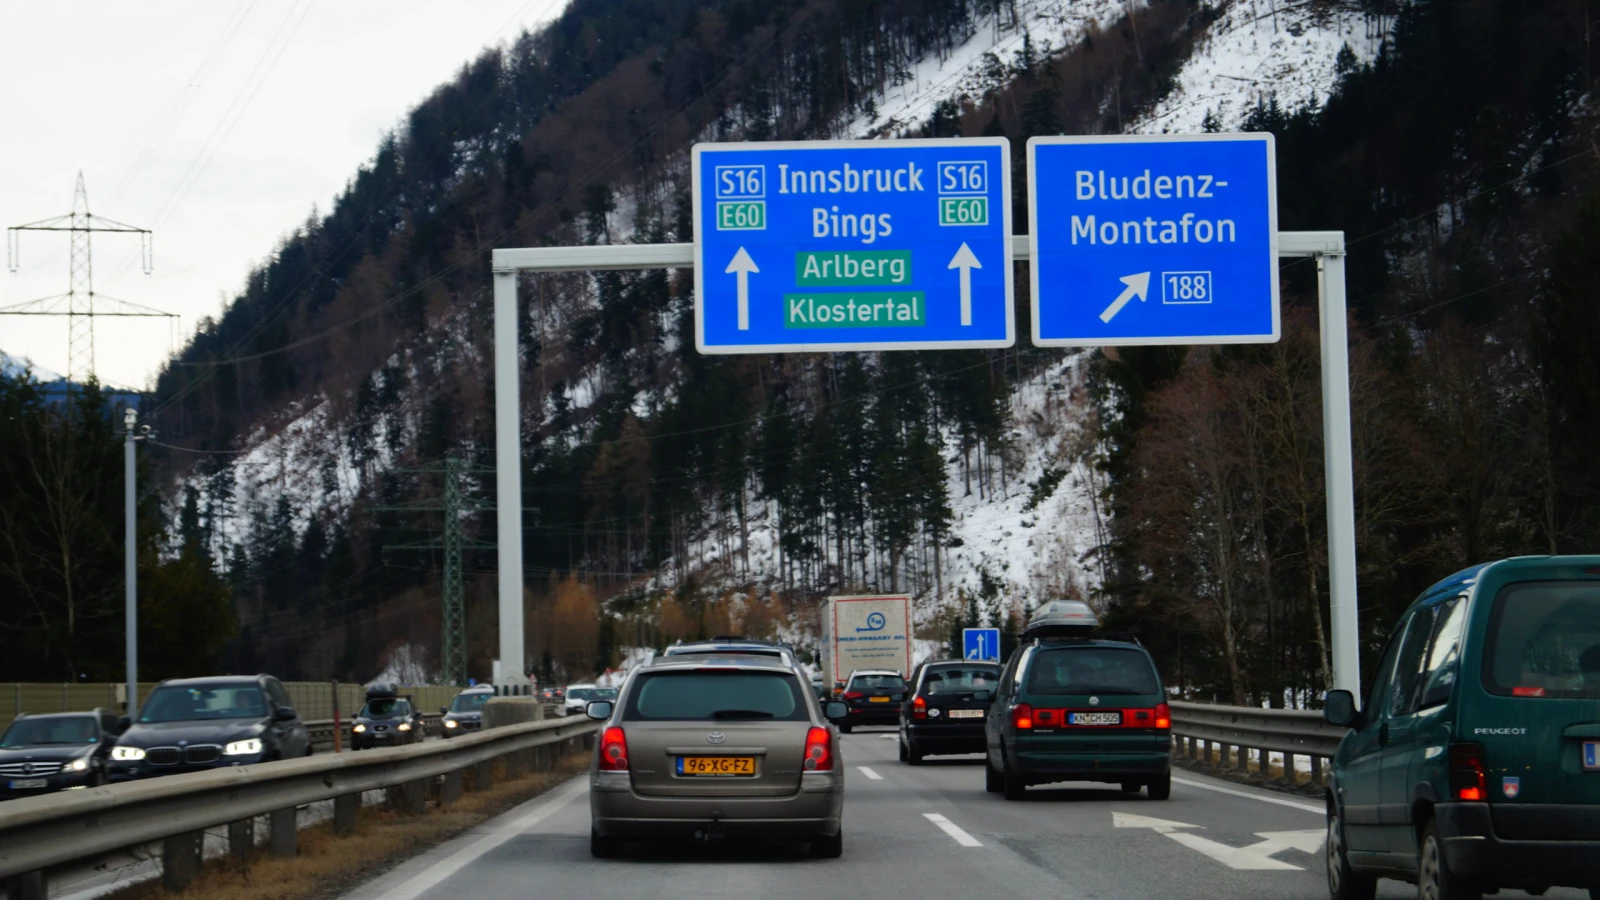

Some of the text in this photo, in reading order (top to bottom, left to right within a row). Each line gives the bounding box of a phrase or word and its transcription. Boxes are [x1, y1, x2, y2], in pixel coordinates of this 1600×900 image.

[720, 169, 760, 196] S16
[778, 161, 924, 194] Innsbruck
[943, 164, 983, 191] S16
[1075, 168, 1229, 201] Bludenz-
[722, 204, 760, 228] E60
[944, 199, 983, 223] E60
[812, 205, 893, 245] Bings
[1070, 212, 1236, 246] Montafon
[802, 253, 906, 284] Arlberg
[1167, 274, 1207, 300] 188
[788, 297, 920, 324] Klostertal
[1073, 712, 1118, 722] KN CH 505
[1474, 727, 1527, 735] PEUGEOT
[688, 758, 750, 772] 96-XG-FZ
